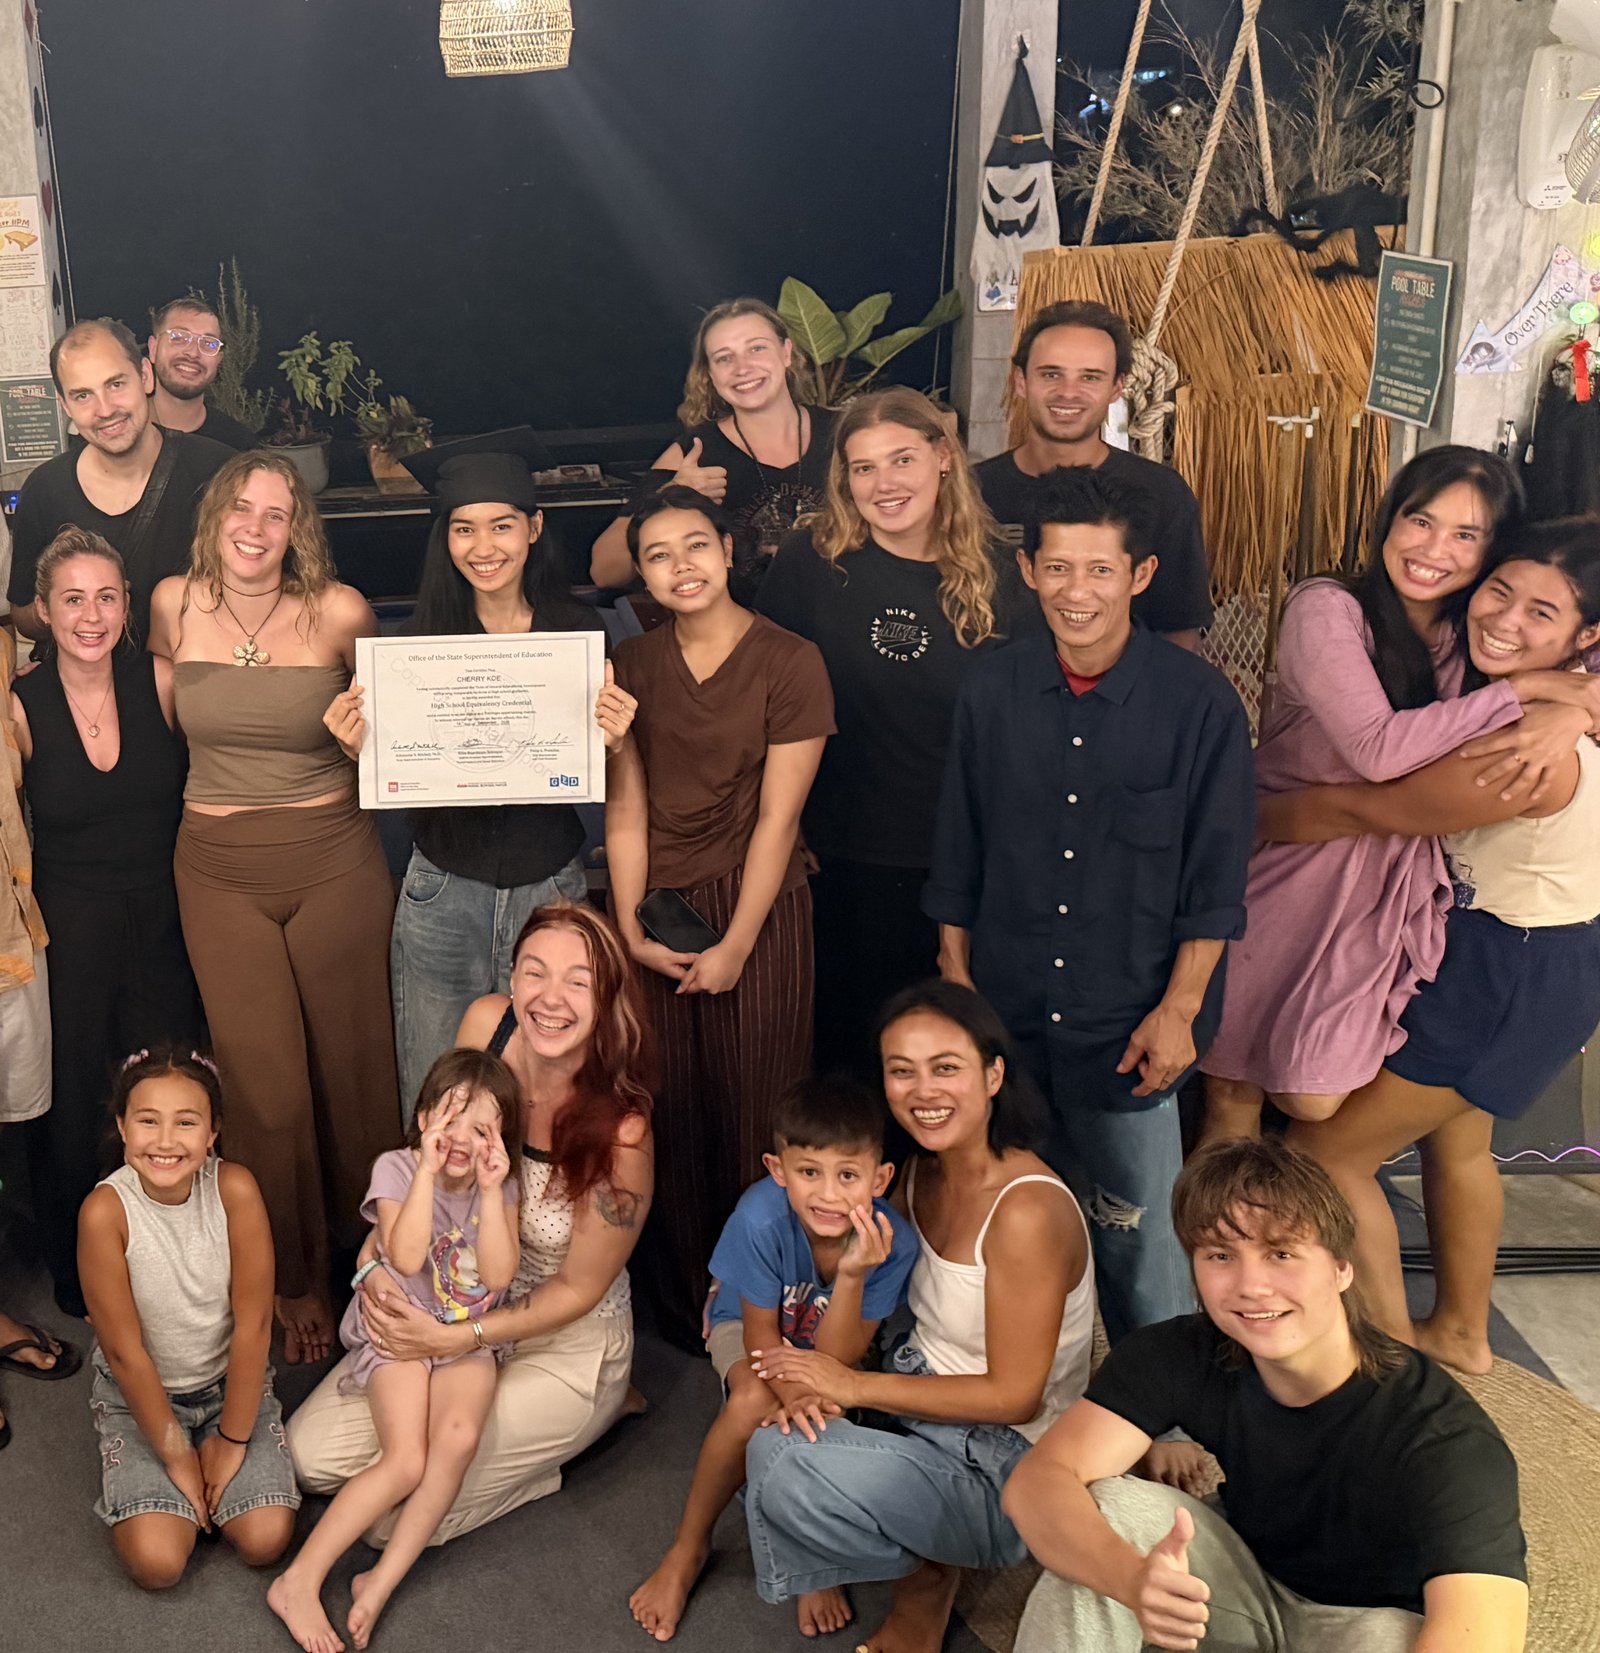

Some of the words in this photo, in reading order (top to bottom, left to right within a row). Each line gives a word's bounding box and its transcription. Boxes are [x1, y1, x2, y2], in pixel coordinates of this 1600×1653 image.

[1391, 275, 1409, 294] POOL
[1412, 279, 1436, 299] TABLE
[1504, 314, 1537, 346] Over
[1533, 282, 1573, 316] There
[26, 387, 47, 397] TABLE
[885, 608, 917, 620] NIKE
[879, 621, 919, 639] NIKE
[870, 618, 909, 661] ATHLETIC
[463, 652, 512, 660] Superintendent
[457, 675, 485, 683] CHERRY
[466, 700, 501, 708] Equivalency
[550, 774, 579, 787] GED
